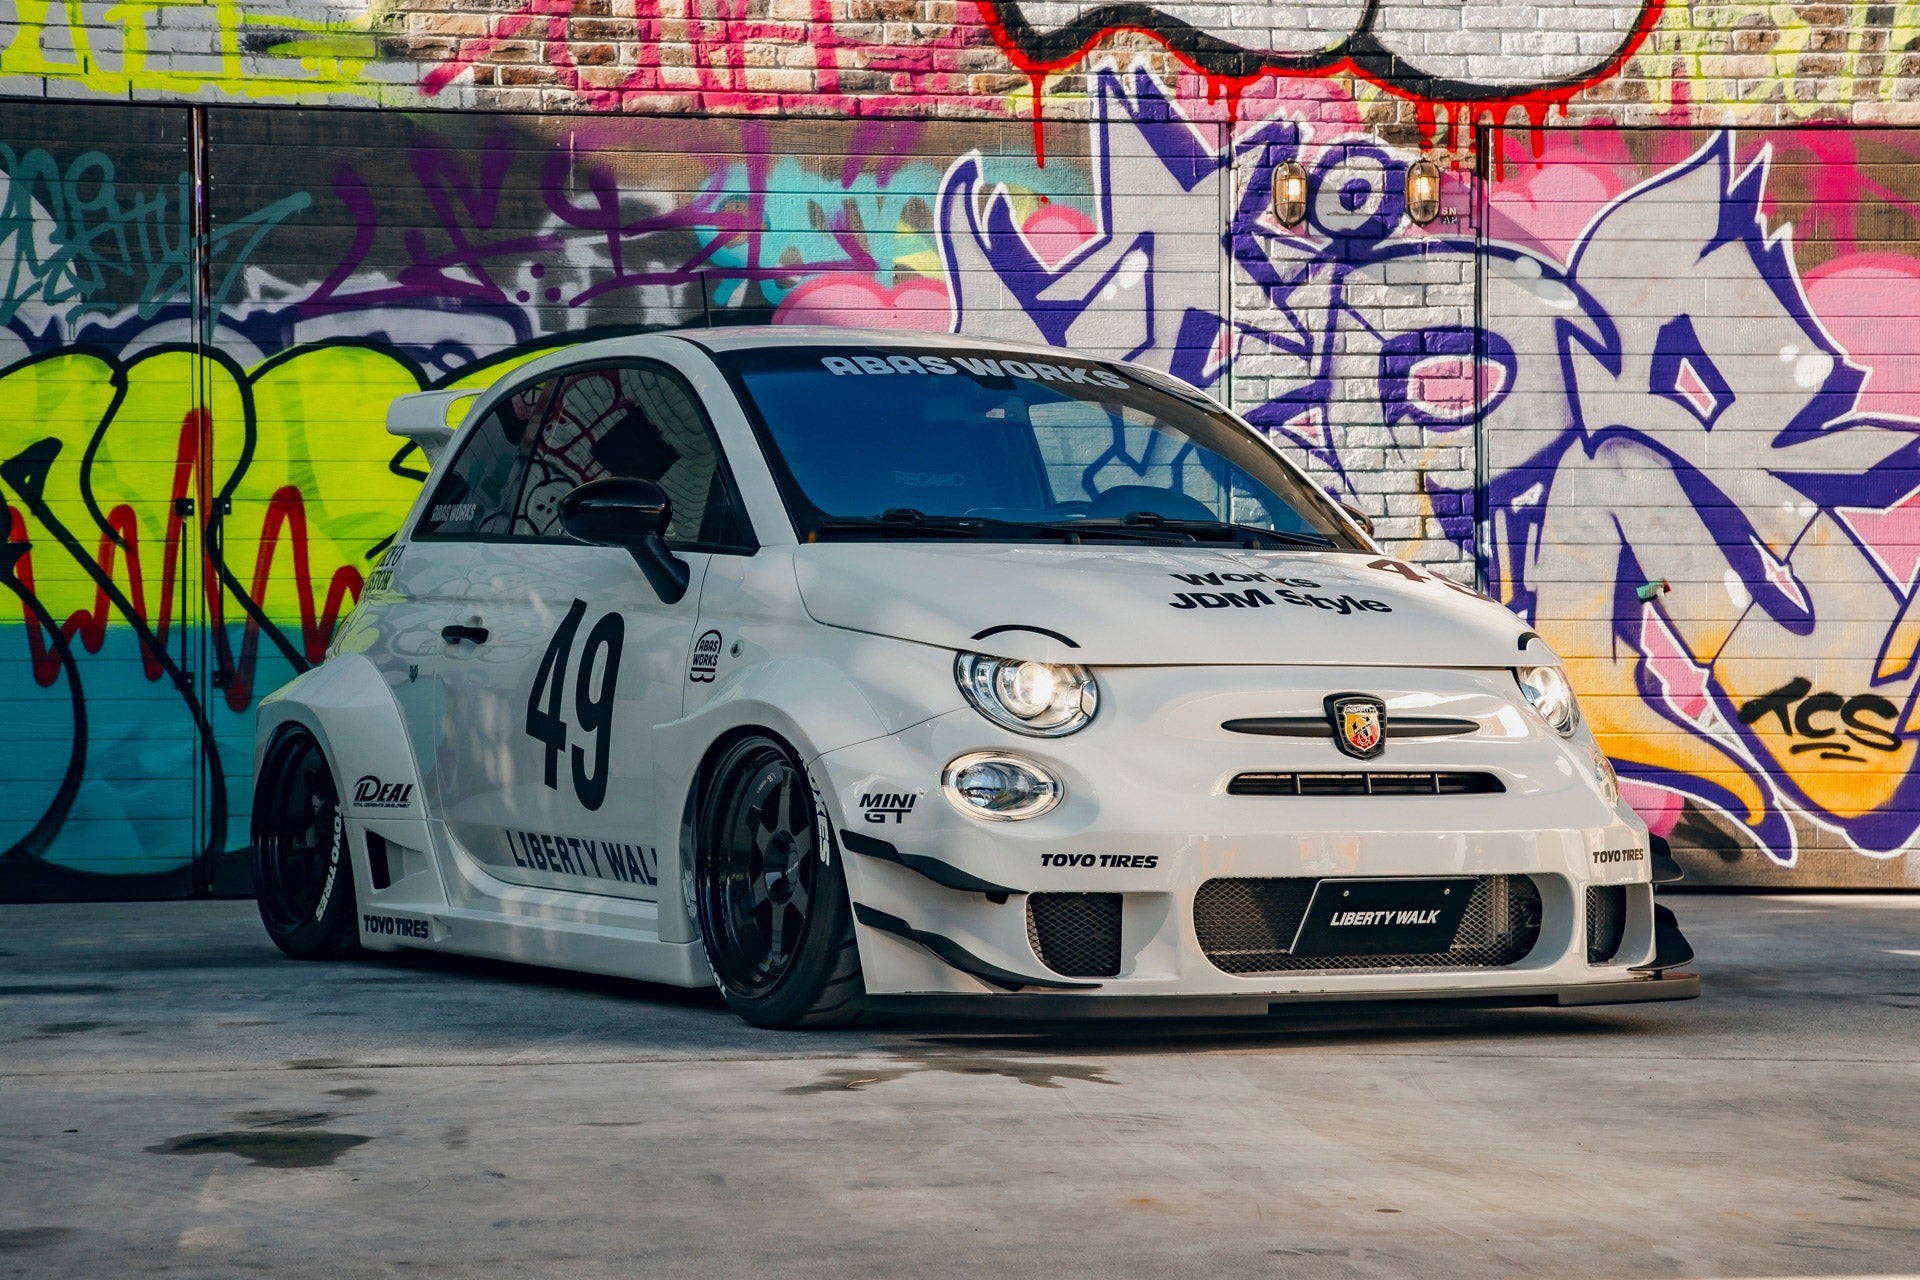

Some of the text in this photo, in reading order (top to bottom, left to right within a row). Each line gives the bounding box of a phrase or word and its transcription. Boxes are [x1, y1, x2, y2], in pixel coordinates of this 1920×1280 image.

[821, 356, 1130, 389] ABAS WORKS
[1169, 571, 1322, 588] Works
[1169, 589, 1392, 615] JDM Style
[698, 640, 719, 652] ABAS
[692, 653, 719, 666] WORKS
[525, 597, 625, 811] 49
[1738, 677, 1902, 751] TCS
[353, 775, 414, 802] IDEAL
[859, 793, 917, 808] MINI
[864, 808, 912, 824] GT
[505, 829, 603, 879] LIBERTY
[1040, 853, 1159, 868] TOYO TIRES
[1593, 848, 1643, 863] TOYO TIRES
[315, 864, 337, 922] TIRES
[363, 914, 429, 939] TOYO TIRES
[1330, 909, 1441, 926] LIBERTY WALK
